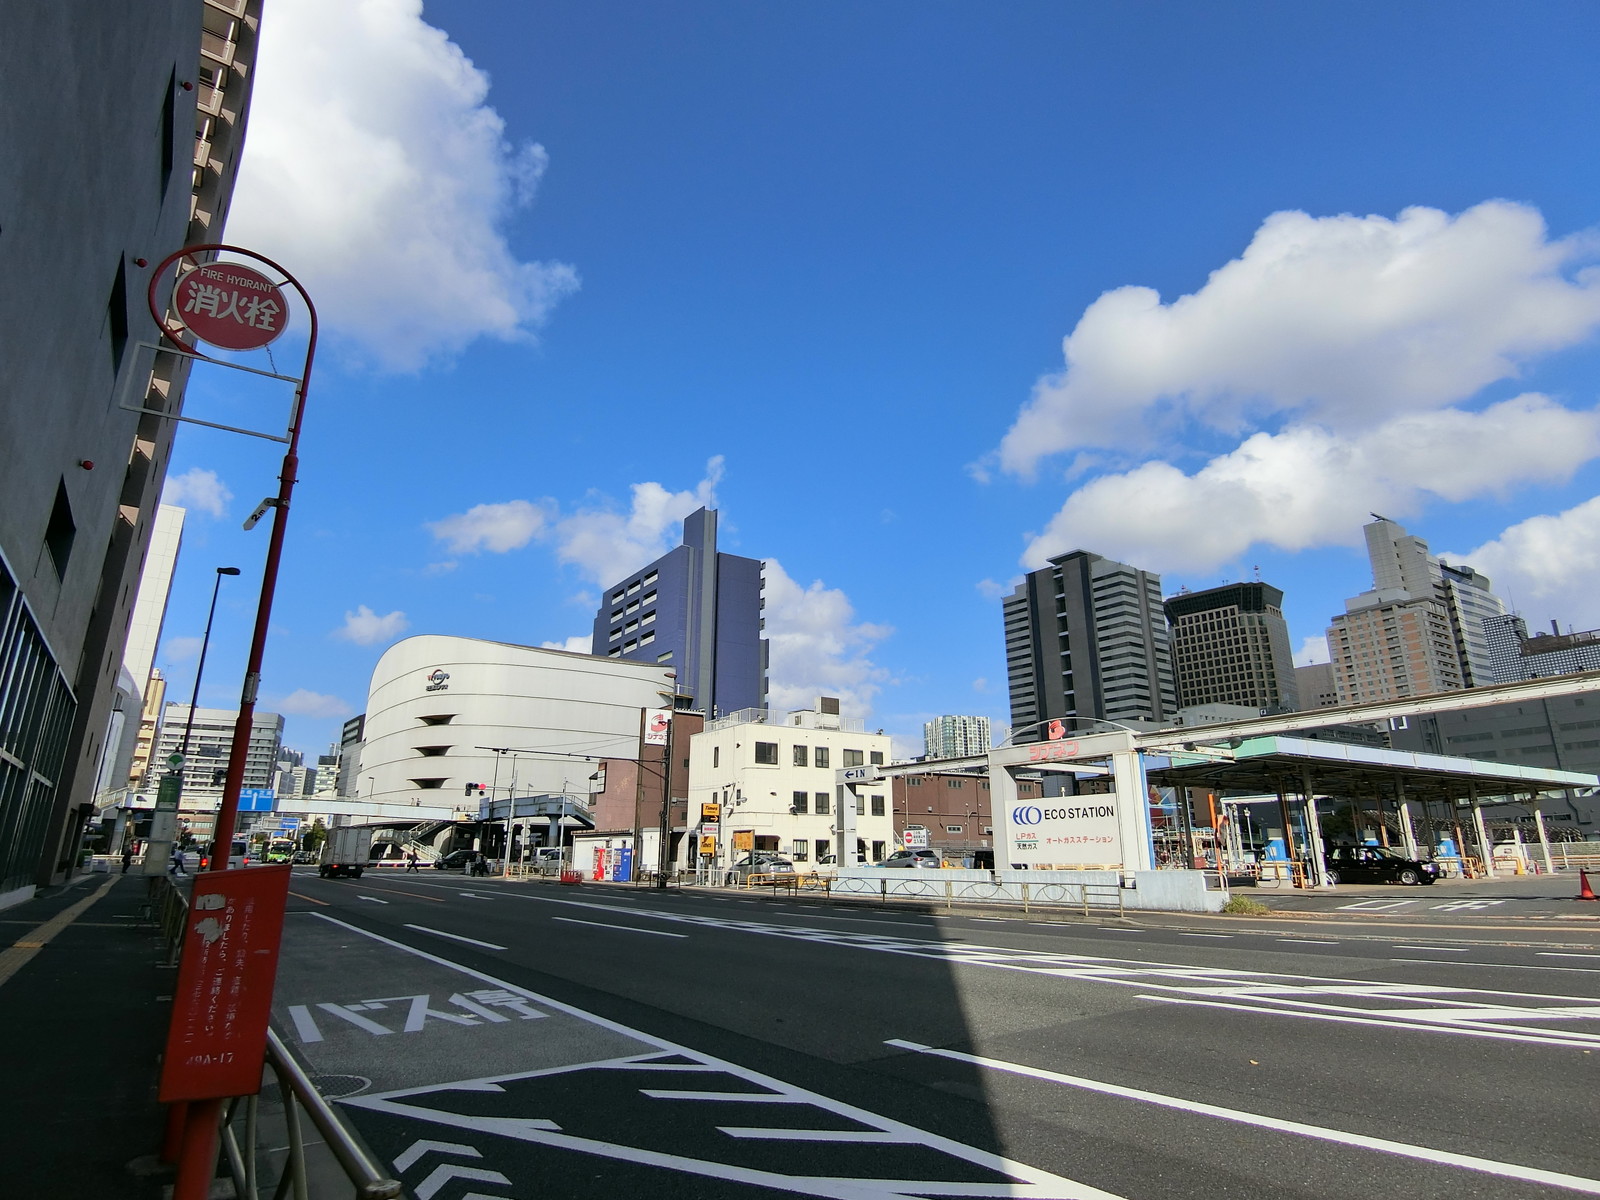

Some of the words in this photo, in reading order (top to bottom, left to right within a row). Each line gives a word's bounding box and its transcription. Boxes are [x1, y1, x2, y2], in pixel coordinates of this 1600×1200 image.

[201, 268, 224, 281] FIRE
[226, 274, 274, 293] HYDRANT
[184, 280, 280, 331] 消火栓
[251, 509, 266, 522] 2m
[1029, 741, 1079, 760] シナネン
[855, 769, 866, 778] IN
[1044, 808, 1066, 820] ECO
[1068, 806, 1114, 819] STATION
[1016, 832, 1037, 840] LPガス
[1046, 836, 1114, 844] オートガスステーション
[1016, 842, 1038, 850] 天然ガス
[288, 989, 550, 1043] バス停
